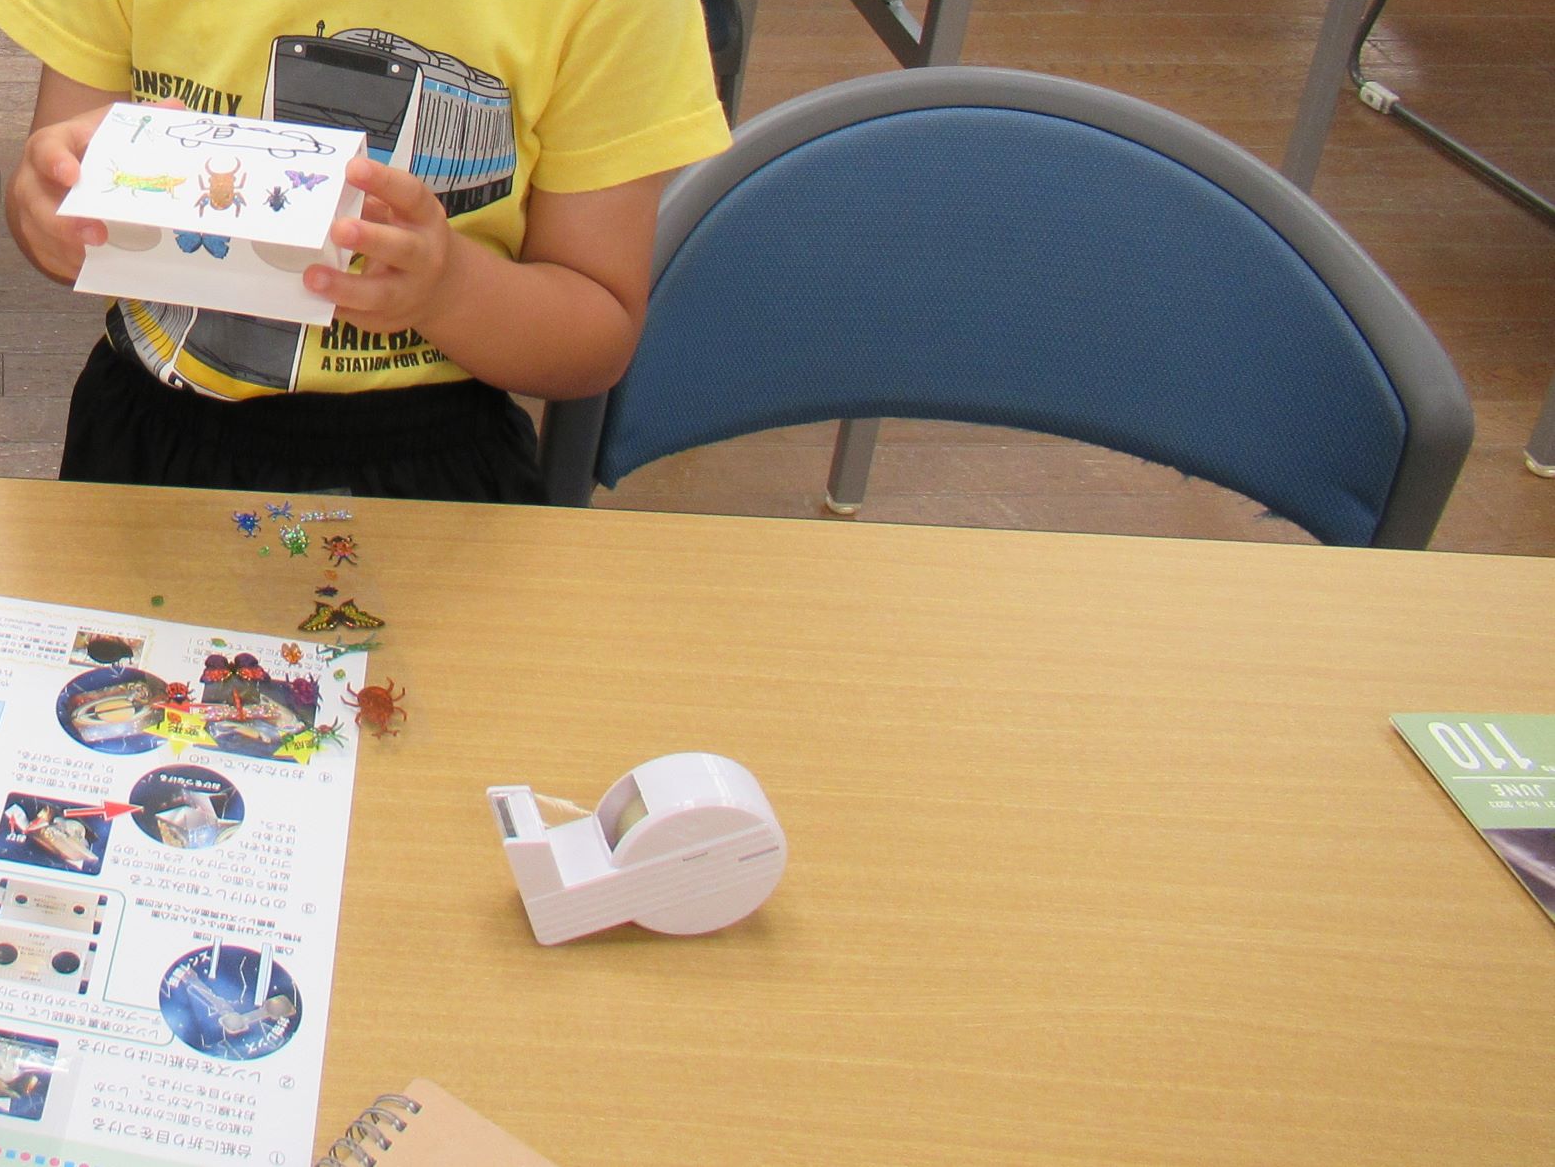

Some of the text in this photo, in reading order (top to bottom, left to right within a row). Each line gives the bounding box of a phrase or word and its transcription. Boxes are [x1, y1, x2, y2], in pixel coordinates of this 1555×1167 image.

[132, 68, 242, 115] ONSTANTLY
[321, 355, 331, 370] A
[334, 356, 391, 372] STATION
[394, 351, 419, 368] FOR
[1428, 722, 1534, 770] 110
[158, 773, 221, 791] おびをつなげる
[1491, 784, 1546, 797] JUNE
[251, 830, 295, 844] はりあわ
[259, 819, 296, 832] せよう。
[237, 840, 293, 856] をそれぞれ
[128, 872, 287, 909] のり付けして組み立てる
[75, 1037, 261, 1083] レンズを台紙にはりつける
[92, 1080, 255, 1120] おれ線にしたがって、しっか
[138, 1073, 256, 1105] りおり目をつけよう。
[89, 1096, 252, 1136] 台紙のうら面にかかれている
[90, 1116, 252, 1159] 台紙に折り目をつける
